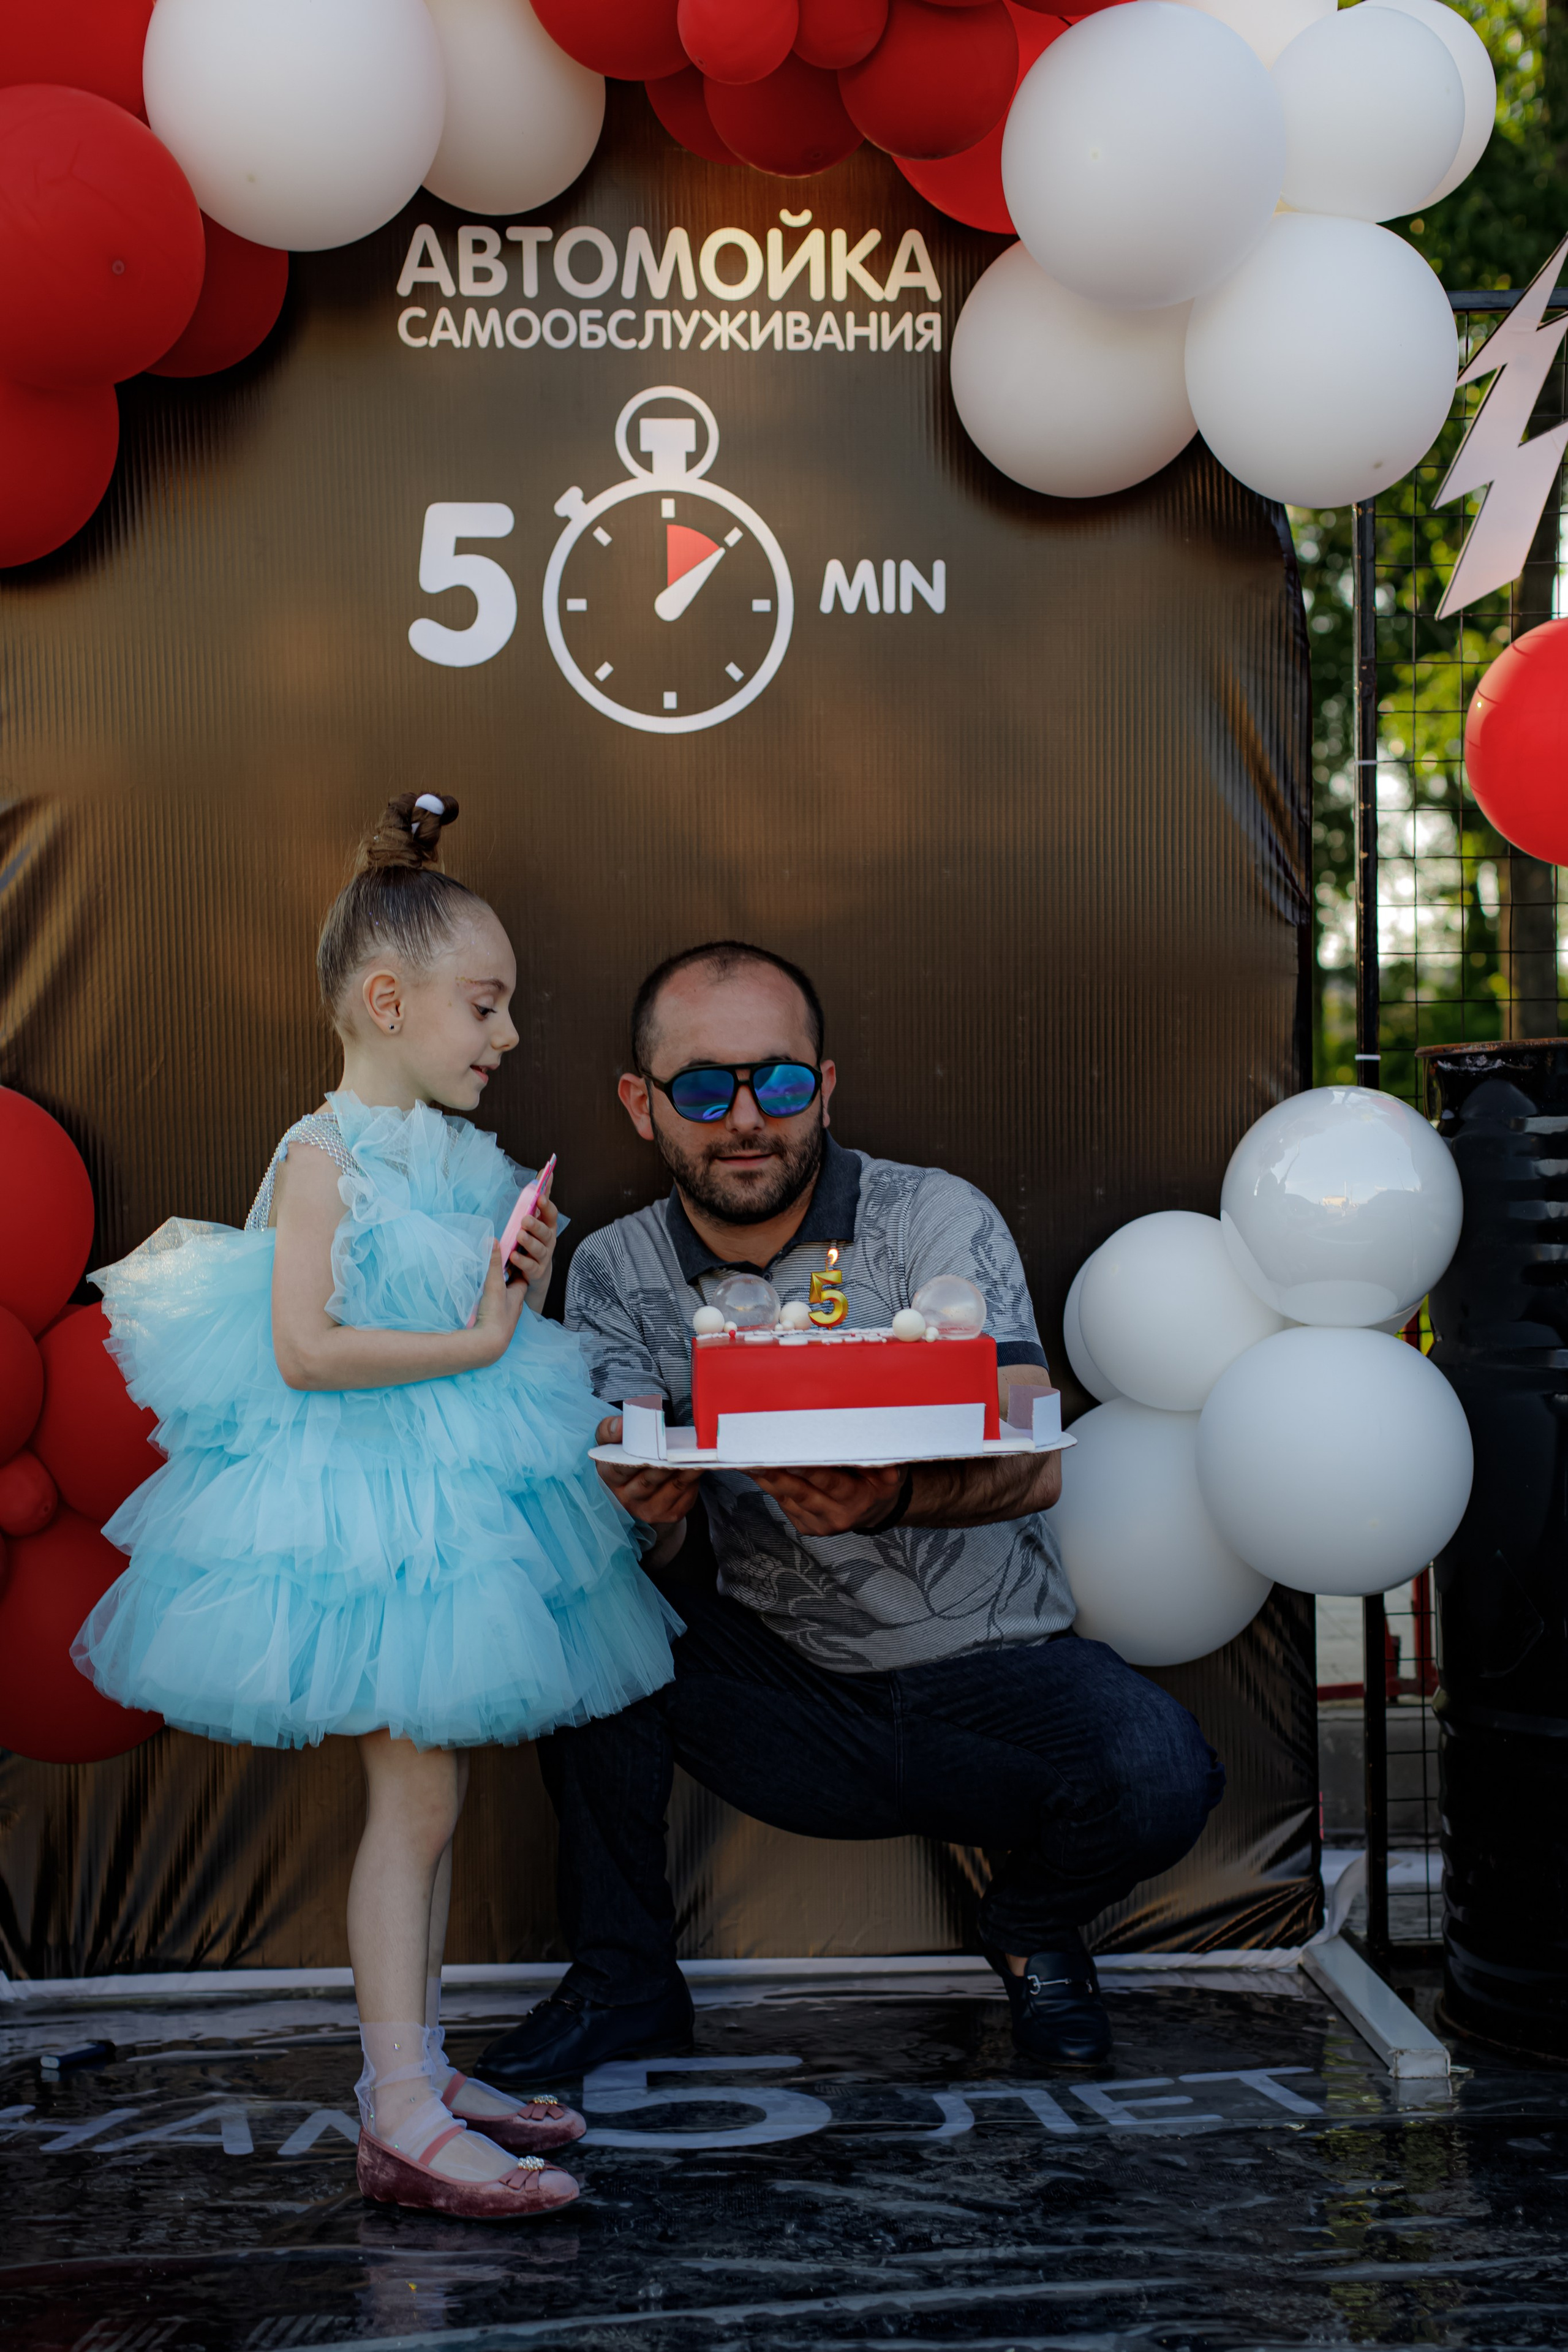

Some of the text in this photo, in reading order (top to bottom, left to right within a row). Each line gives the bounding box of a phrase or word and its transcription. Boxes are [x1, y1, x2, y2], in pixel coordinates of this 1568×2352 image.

[396, 208, 942, 302] АВТОМОЙКА
[397, 306, 942, 352] САМООБСЛУЖИВАНИЯ
[407, 501, 946, 668] 5 MIN
[573, 2056, 832, 2150] 5
[919, 2066, 1324, 2138] ЛЕТ
